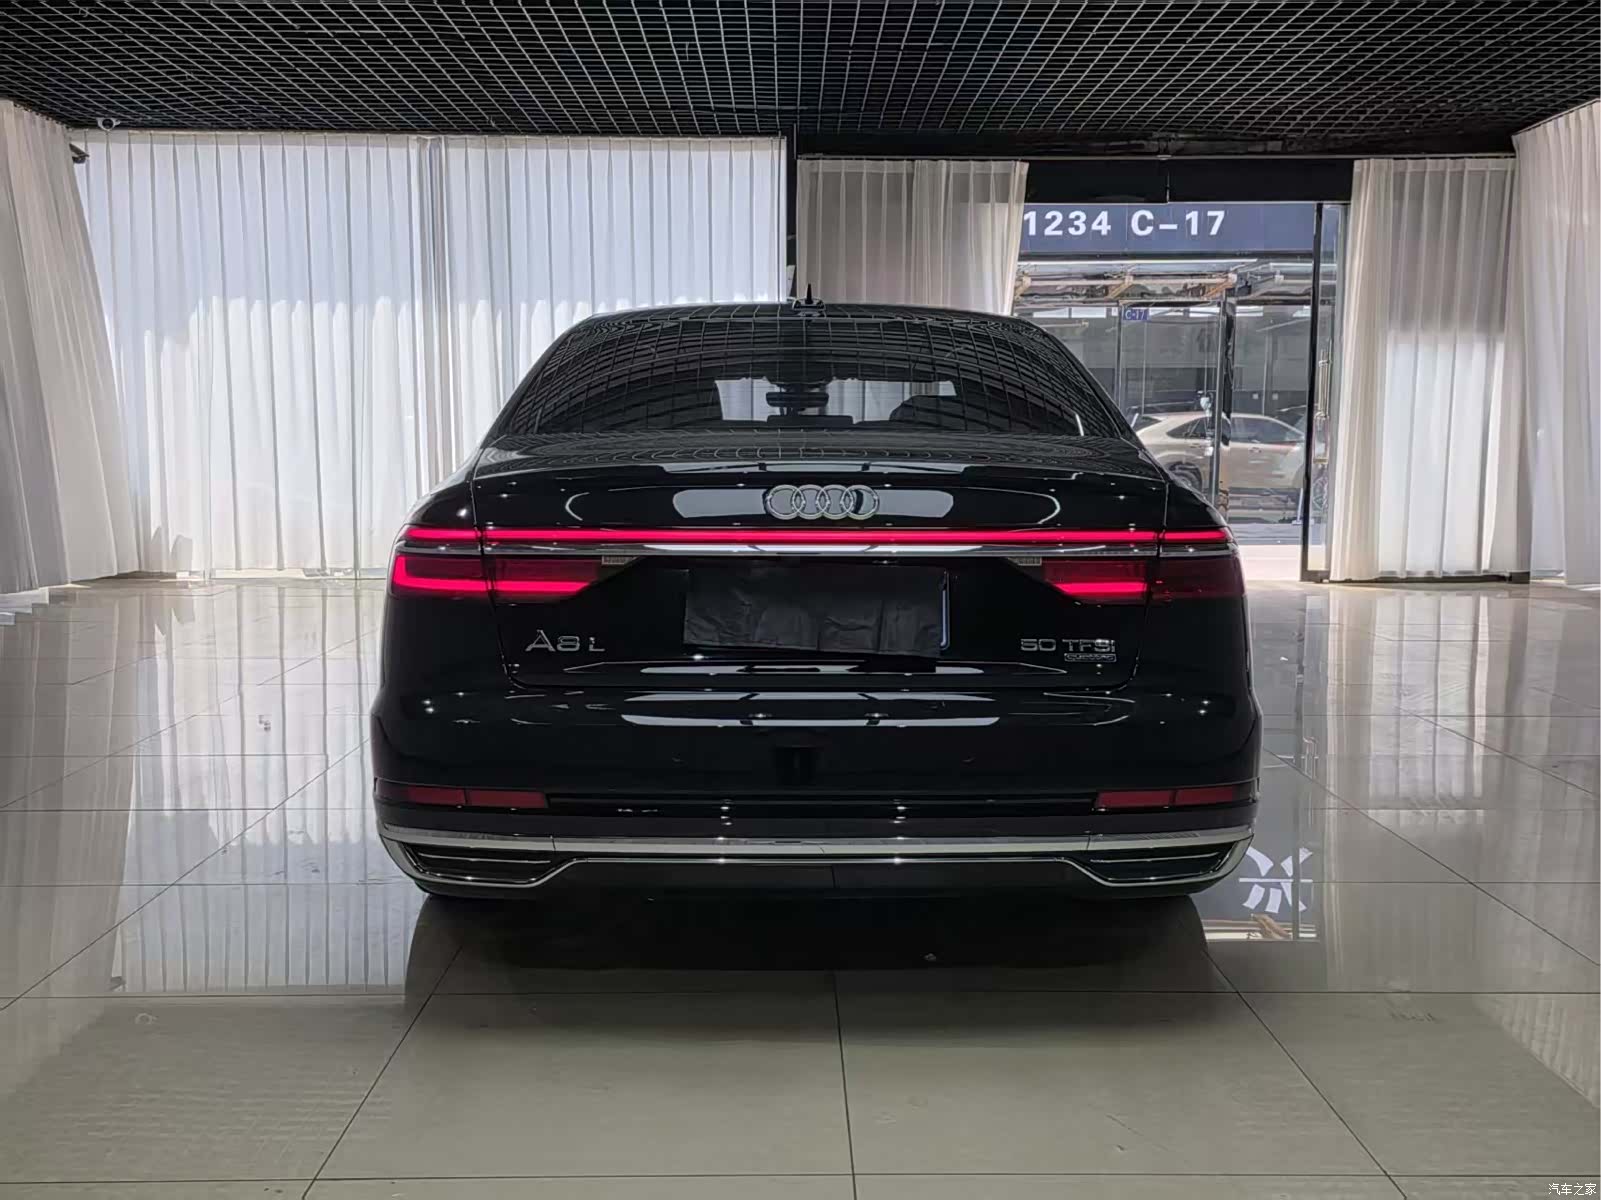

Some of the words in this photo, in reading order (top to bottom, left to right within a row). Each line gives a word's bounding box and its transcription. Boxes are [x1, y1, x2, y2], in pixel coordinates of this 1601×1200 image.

[1024, 211, 1111, 236] 1234
[1131, 209, 1225, 236] C-17
[1020, 638, 1057, 651] 50
